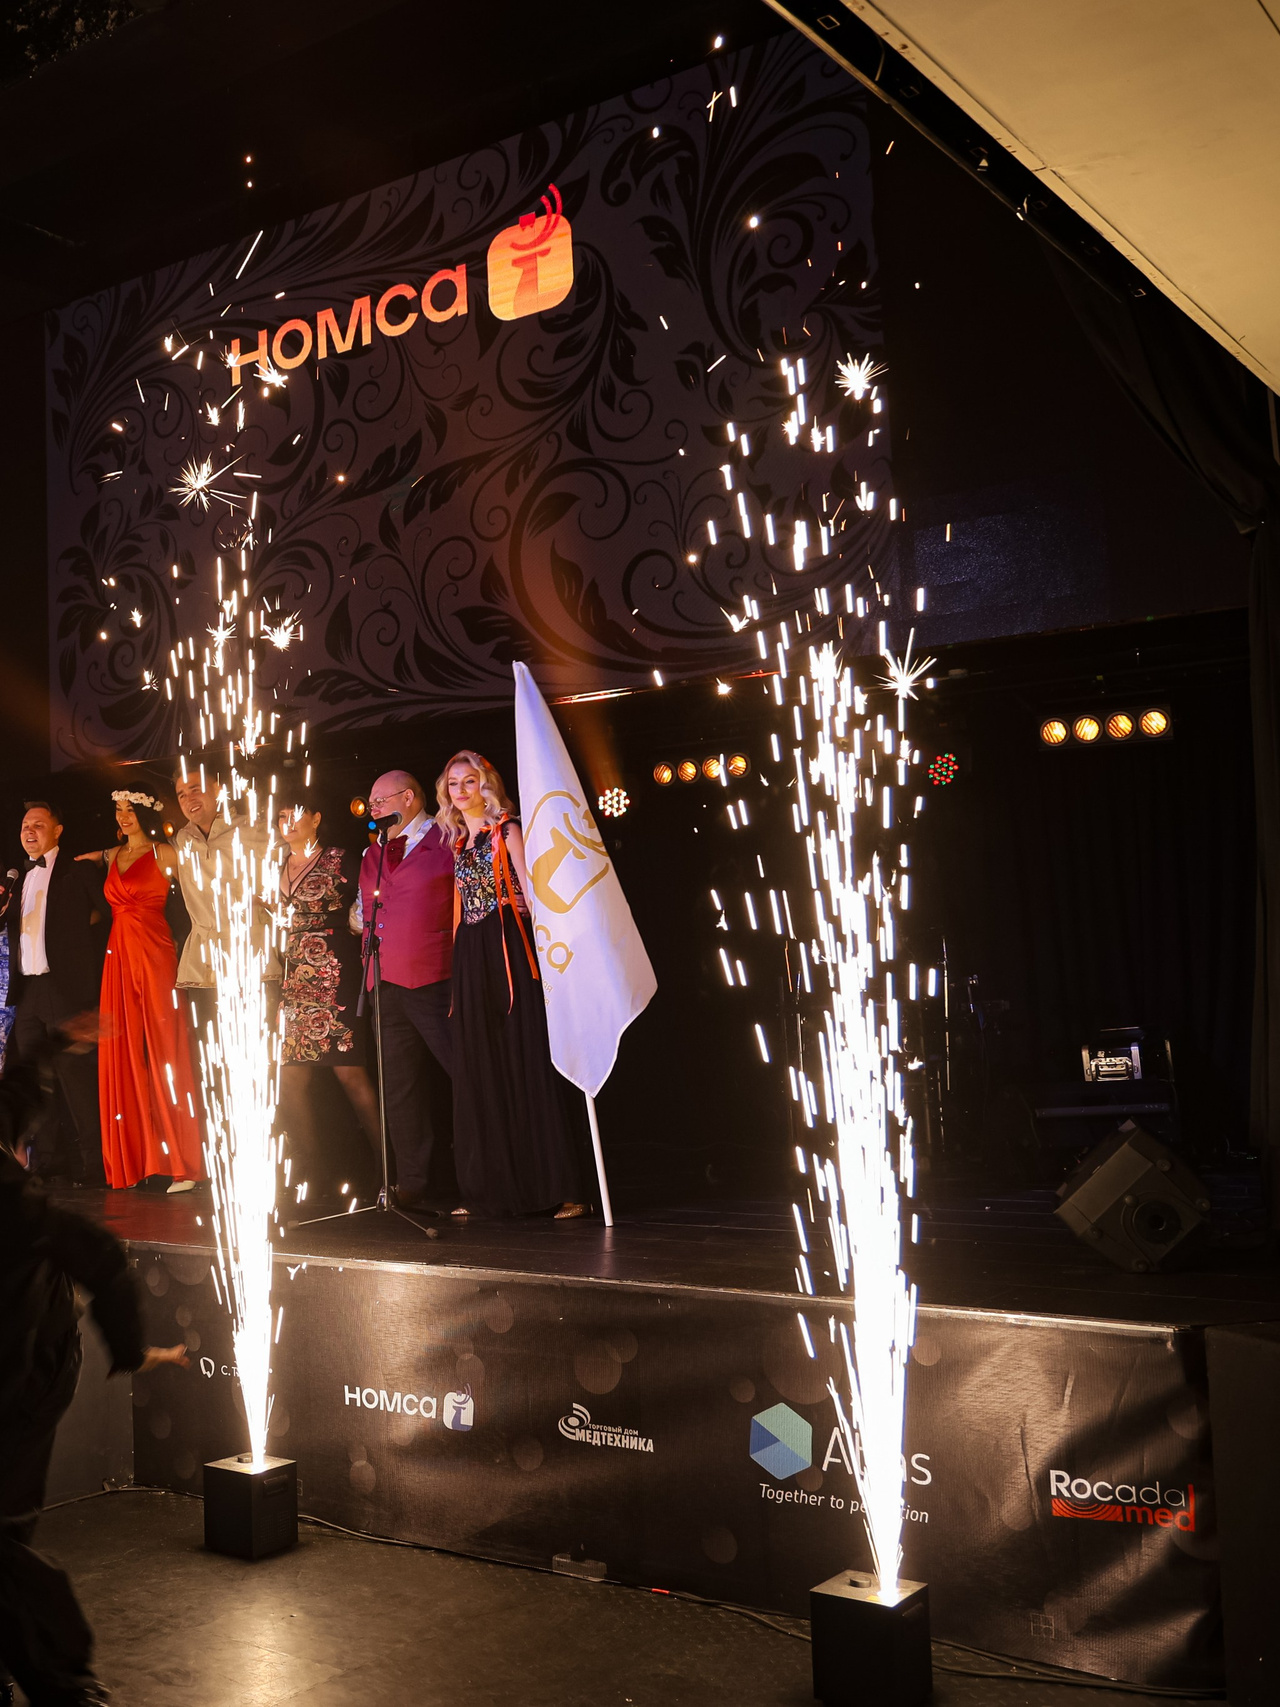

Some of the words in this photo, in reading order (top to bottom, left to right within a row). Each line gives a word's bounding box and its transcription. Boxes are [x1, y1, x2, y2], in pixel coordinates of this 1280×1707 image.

[574, 1428, 655, 1453] МЕДТЕХНИКА
[588, 1423, 623, 1434] ТОРГОВЫЙ
[623, 1428, 639, 1436] ДОМ
[759, 1482, 825, 1507] Together
[829, 1494, 845, 1510] to
[1049, 1469, 1186, 1507] Rocada
[1125, 1483, 1196, 1532] med
